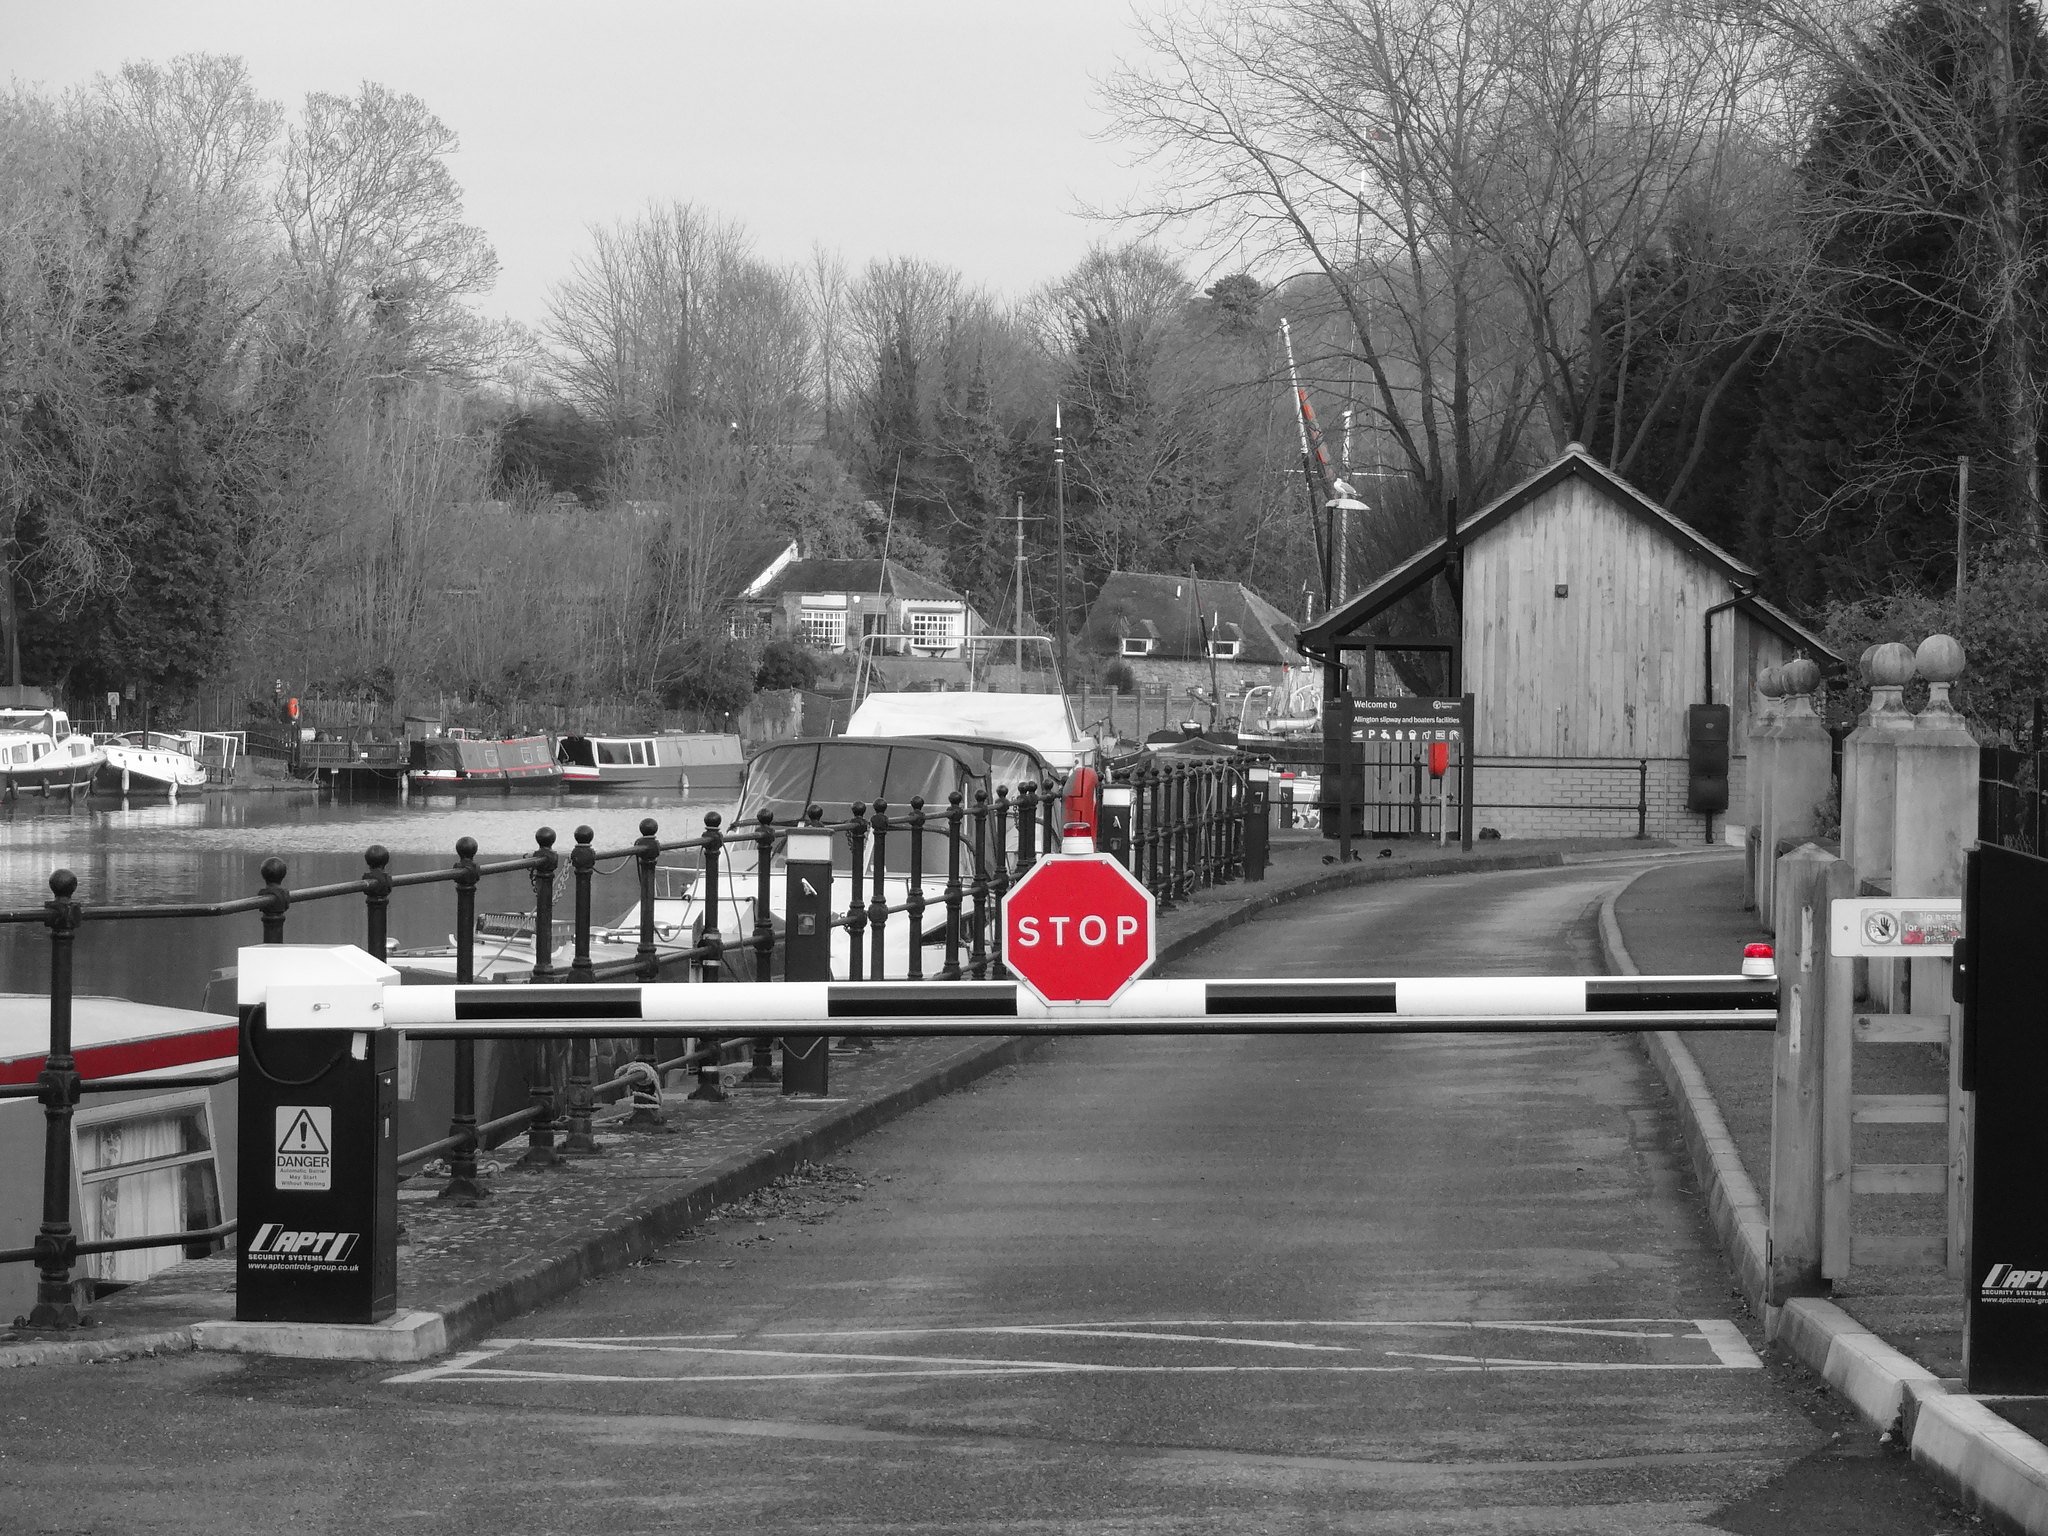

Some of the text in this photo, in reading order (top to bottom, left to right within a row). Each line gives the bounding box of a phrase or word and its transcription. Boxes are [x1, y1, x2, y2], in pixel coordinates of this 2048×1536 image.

[1354, 700, 1397, 709] Welcome to
[1353, 716, 1380, 724] Allington
[1380, 716, 1401, 725] slipway
[1018, 915, 1138, 946] STOP
[277, 1156, 330, 1168] DANGER
[248, 1253, 324, 1262] SECURITY SYSTEMS
[248, 1263, 359, 1272] www.aptcontrols-group.co.uk
